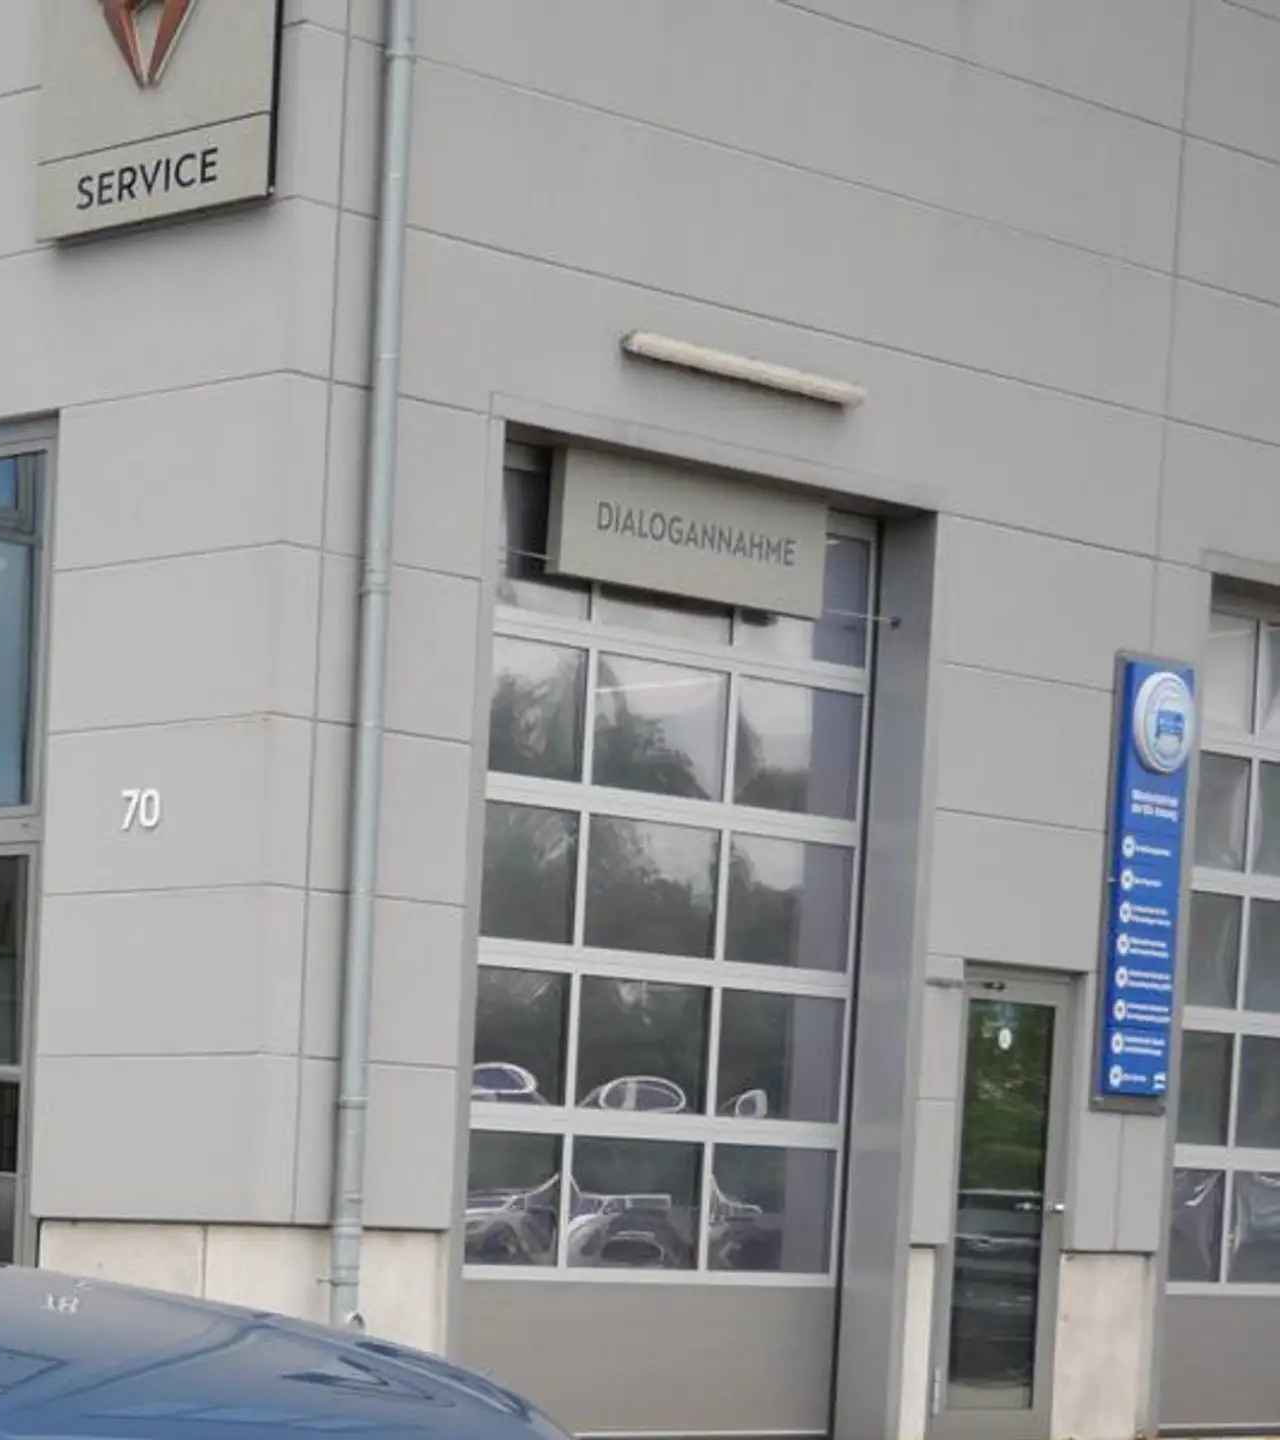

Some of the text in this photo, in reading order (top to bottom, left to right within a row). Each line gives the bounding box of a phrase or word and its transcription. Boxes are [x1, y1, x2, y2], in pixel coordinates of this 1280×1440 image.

[76, 147, 218, 210] SERVICE
[596, 500, 797, 567] DIALOGANNAHME
[120, 788, 160, 830] 70
